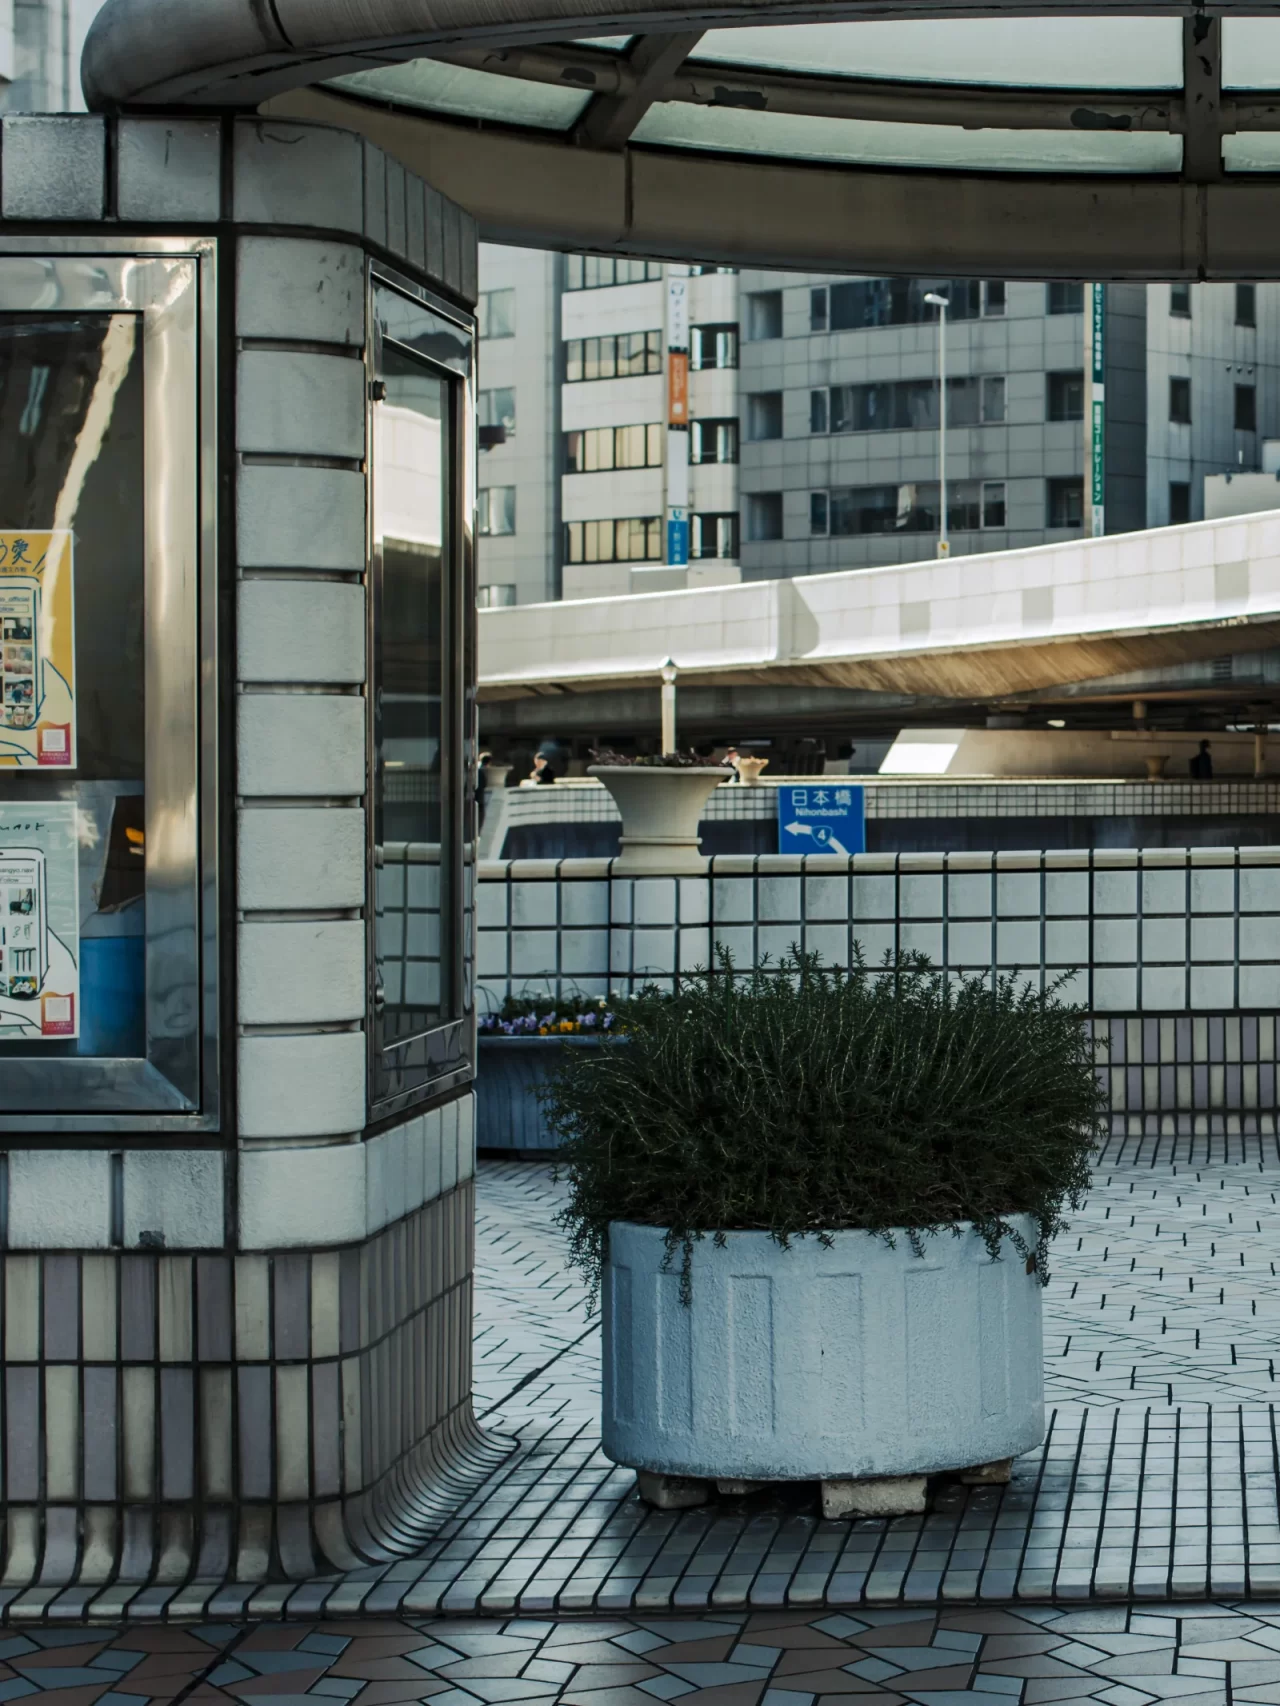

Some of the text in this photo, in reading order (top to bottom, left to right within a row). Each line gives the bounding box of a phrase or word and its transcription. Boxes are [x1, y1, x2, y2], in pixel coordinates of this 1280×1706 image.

[792, 789, 852, 806] 日本橋
[795, 807, 848, 816] Nihonbashi
[817, 829, 826, 841] 4
